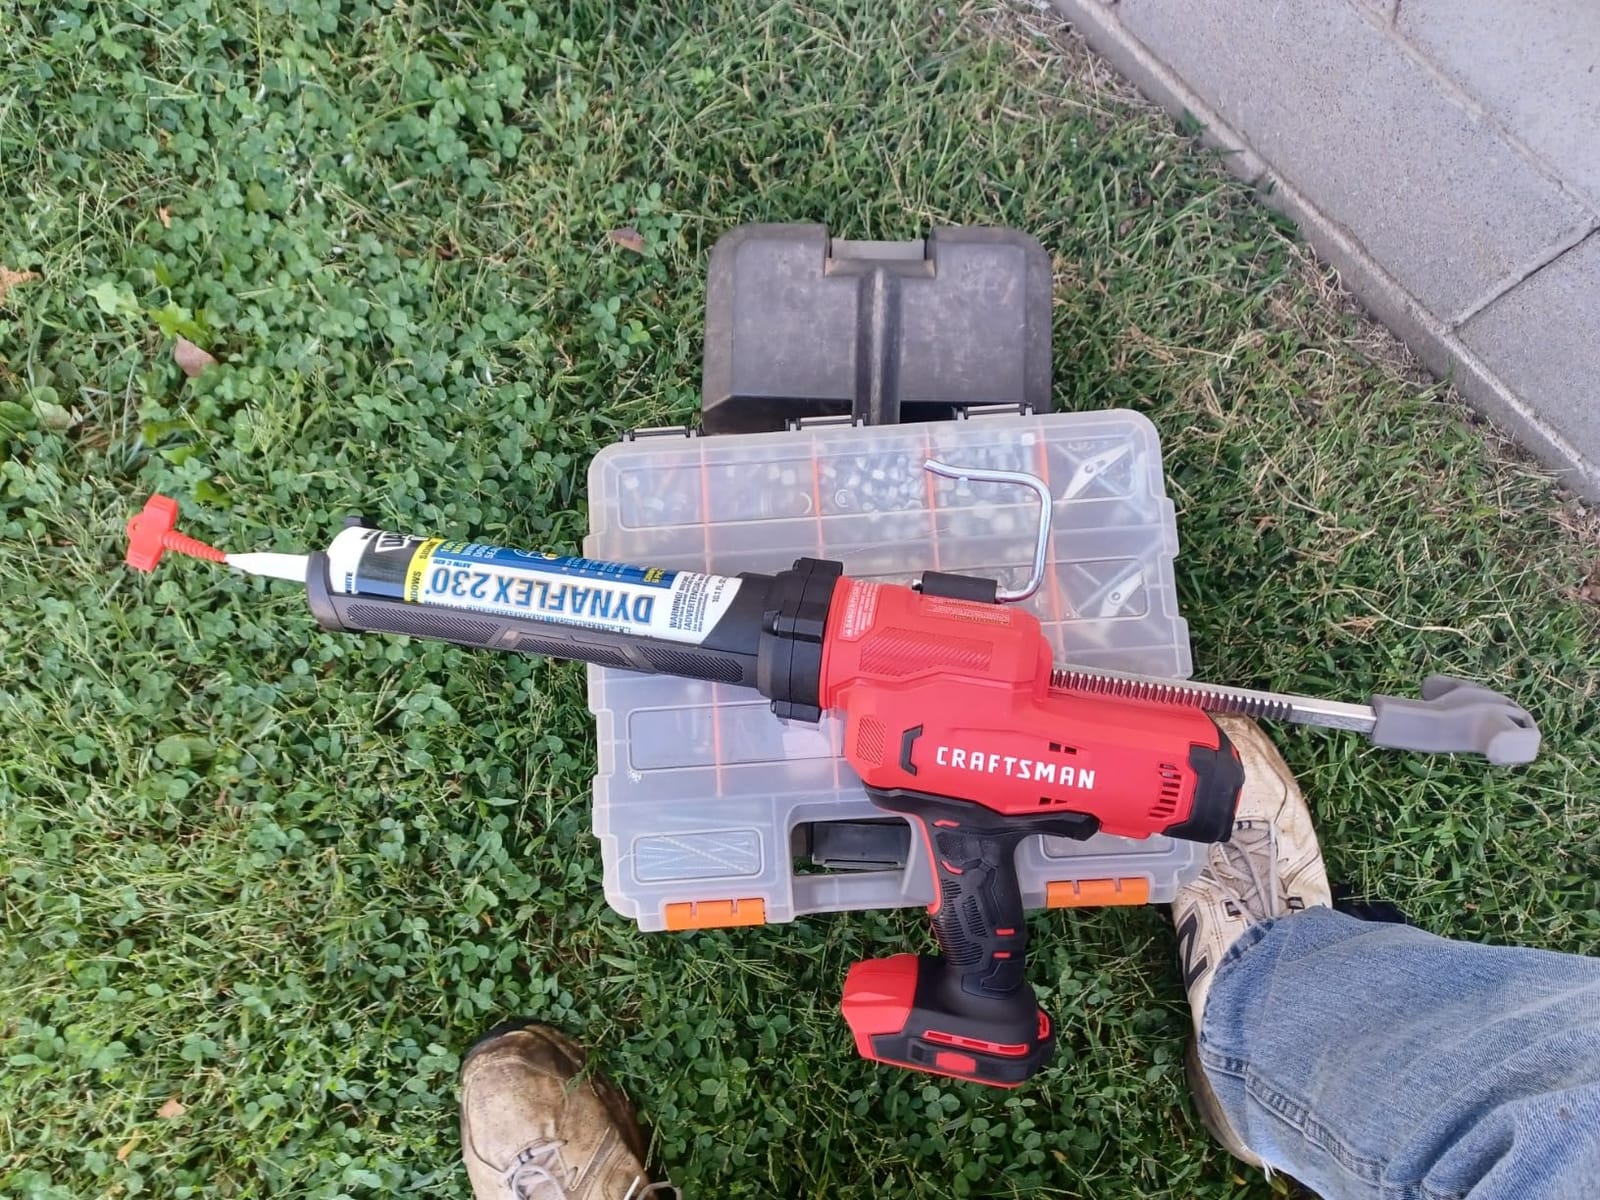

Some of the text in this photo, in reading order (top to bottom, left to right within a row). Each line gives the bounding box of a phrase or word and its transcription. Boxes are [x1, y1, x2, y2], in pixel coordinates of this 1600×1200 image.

[409, 571, 422, 603] NDOWS
[431, 567, 487, 599] 230
[496, 575, 657, 624] DYNAFLEX
[936, 745, 1097, 790] CRAFTSMAN
